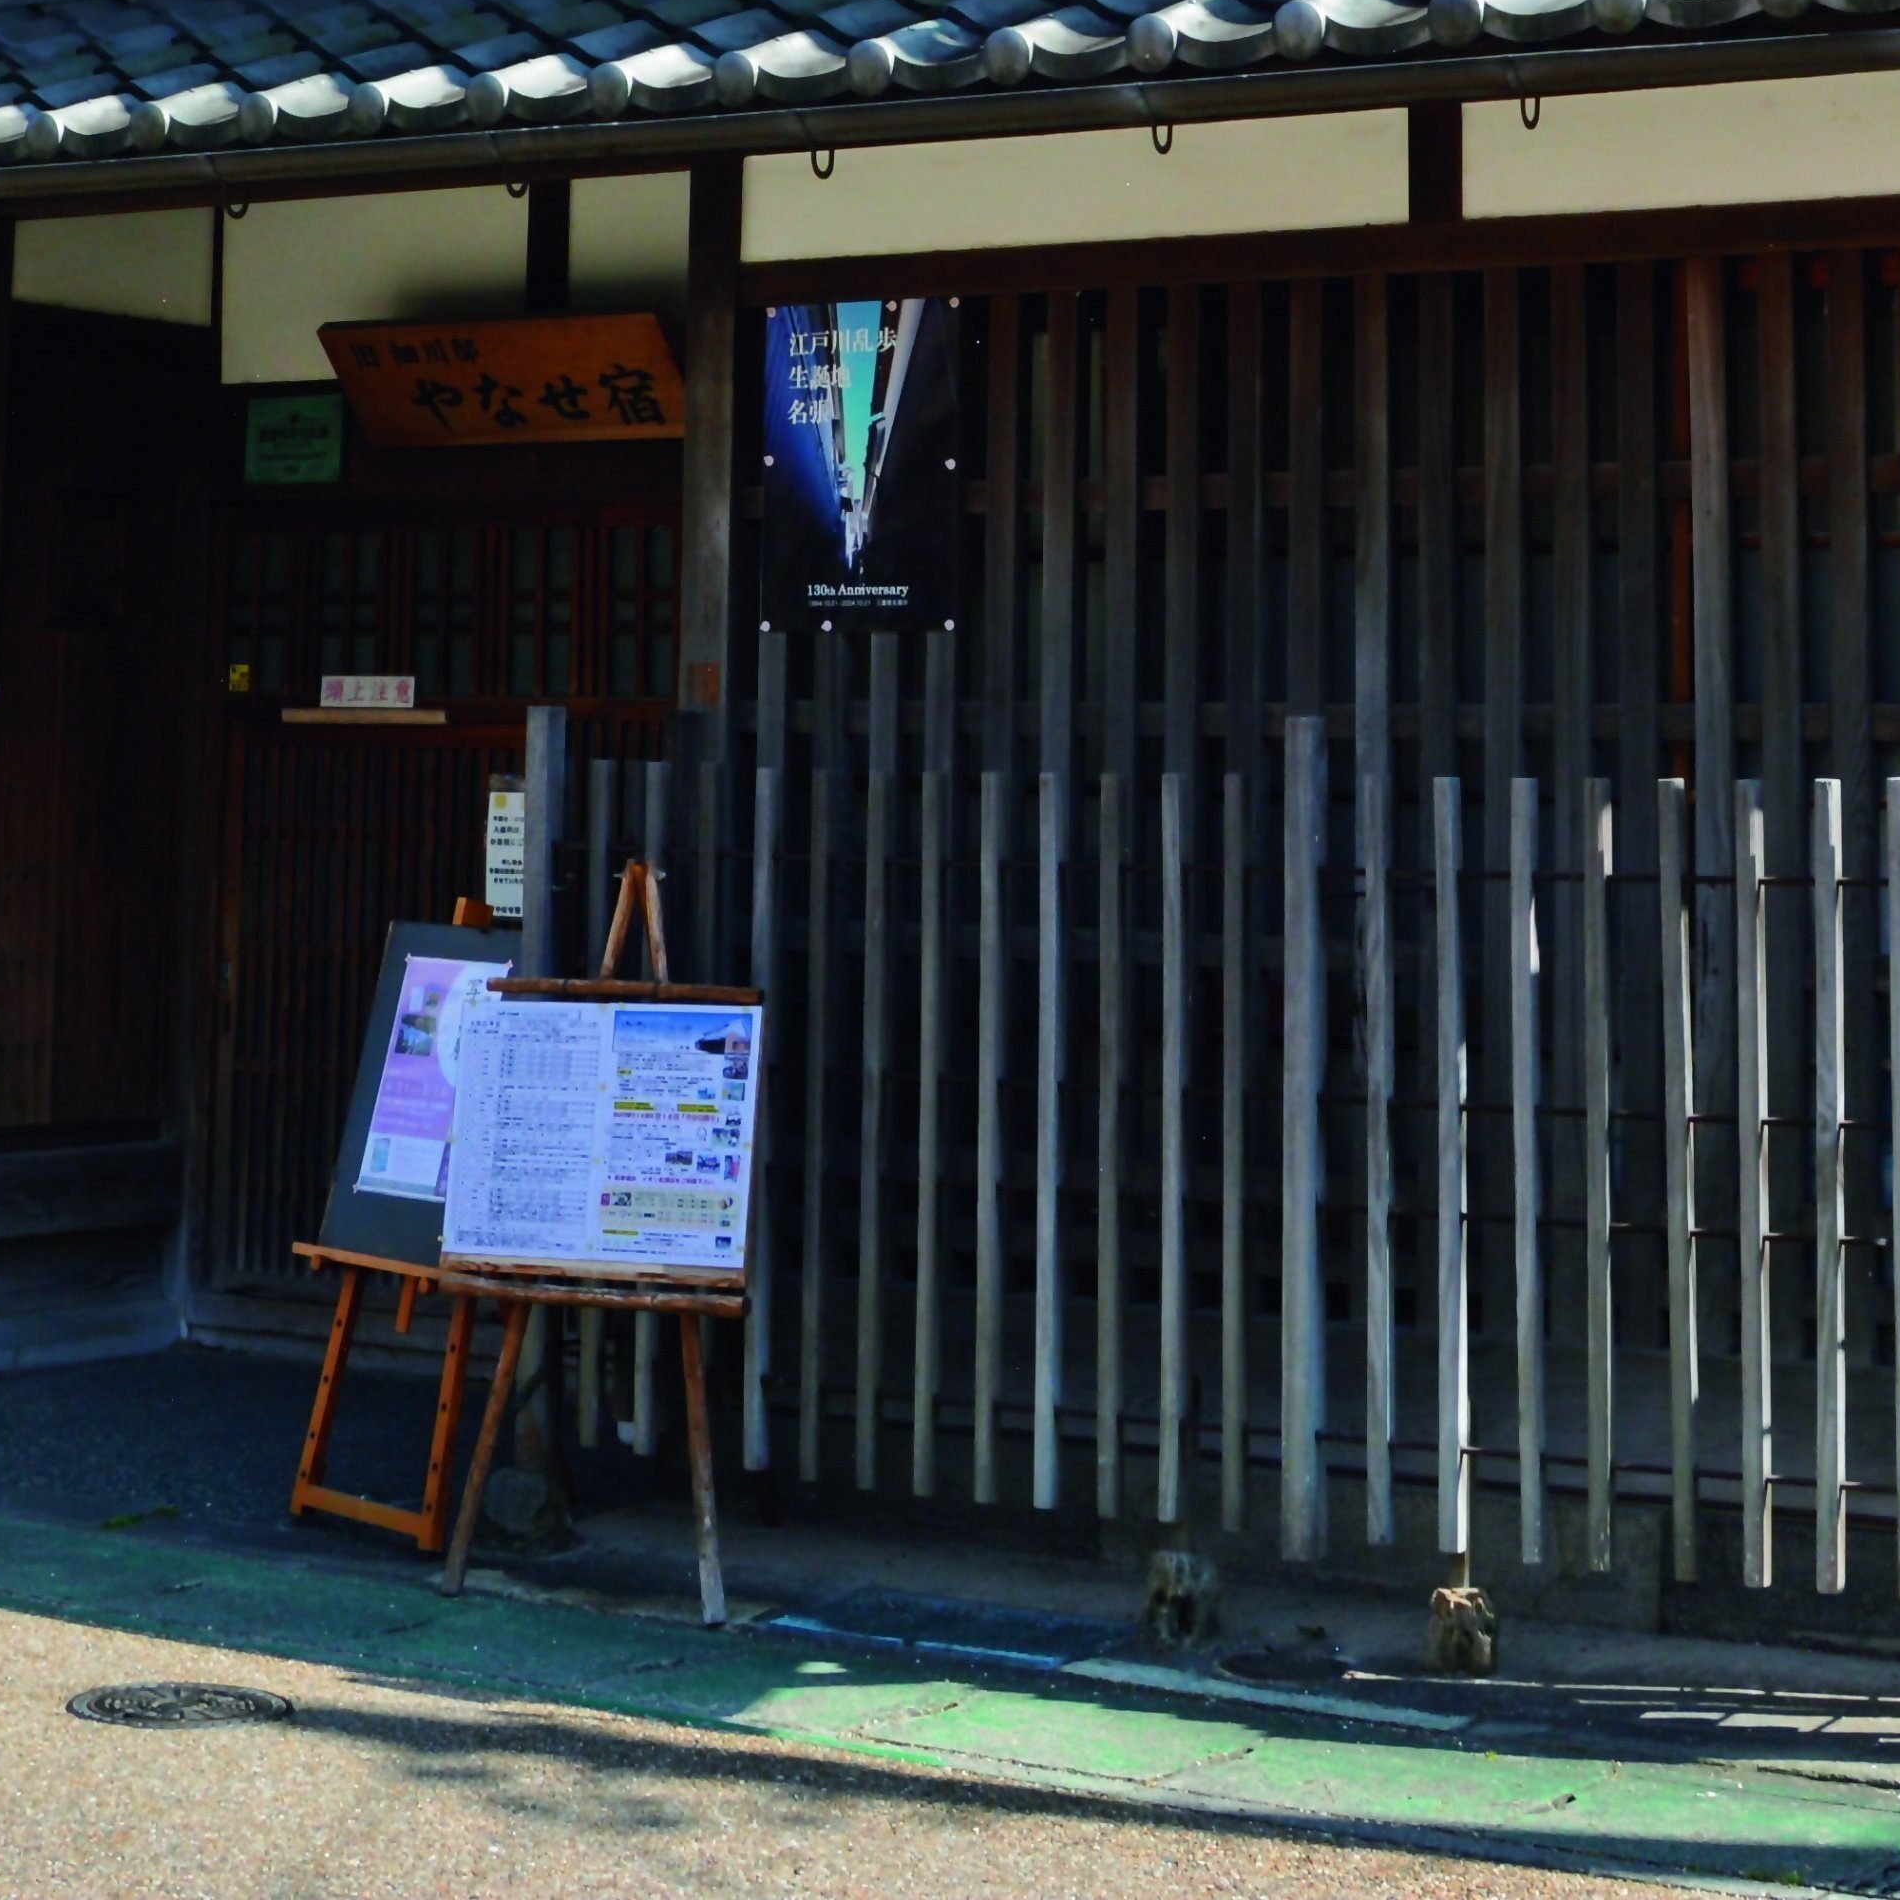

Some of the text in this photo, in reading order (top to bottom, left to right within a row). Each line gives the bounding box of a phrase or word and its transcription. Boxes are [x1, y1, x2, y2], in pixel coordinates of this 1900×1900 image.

[789, 326, 898, 357] 江戸川乱歩
[788, 364, 851, 389] 生誕地
[411, 363, 666, 428] やなせ宿
[787, 399, 835, 425] 名張
[807, 583, 909, 597] 130th Anniversary
